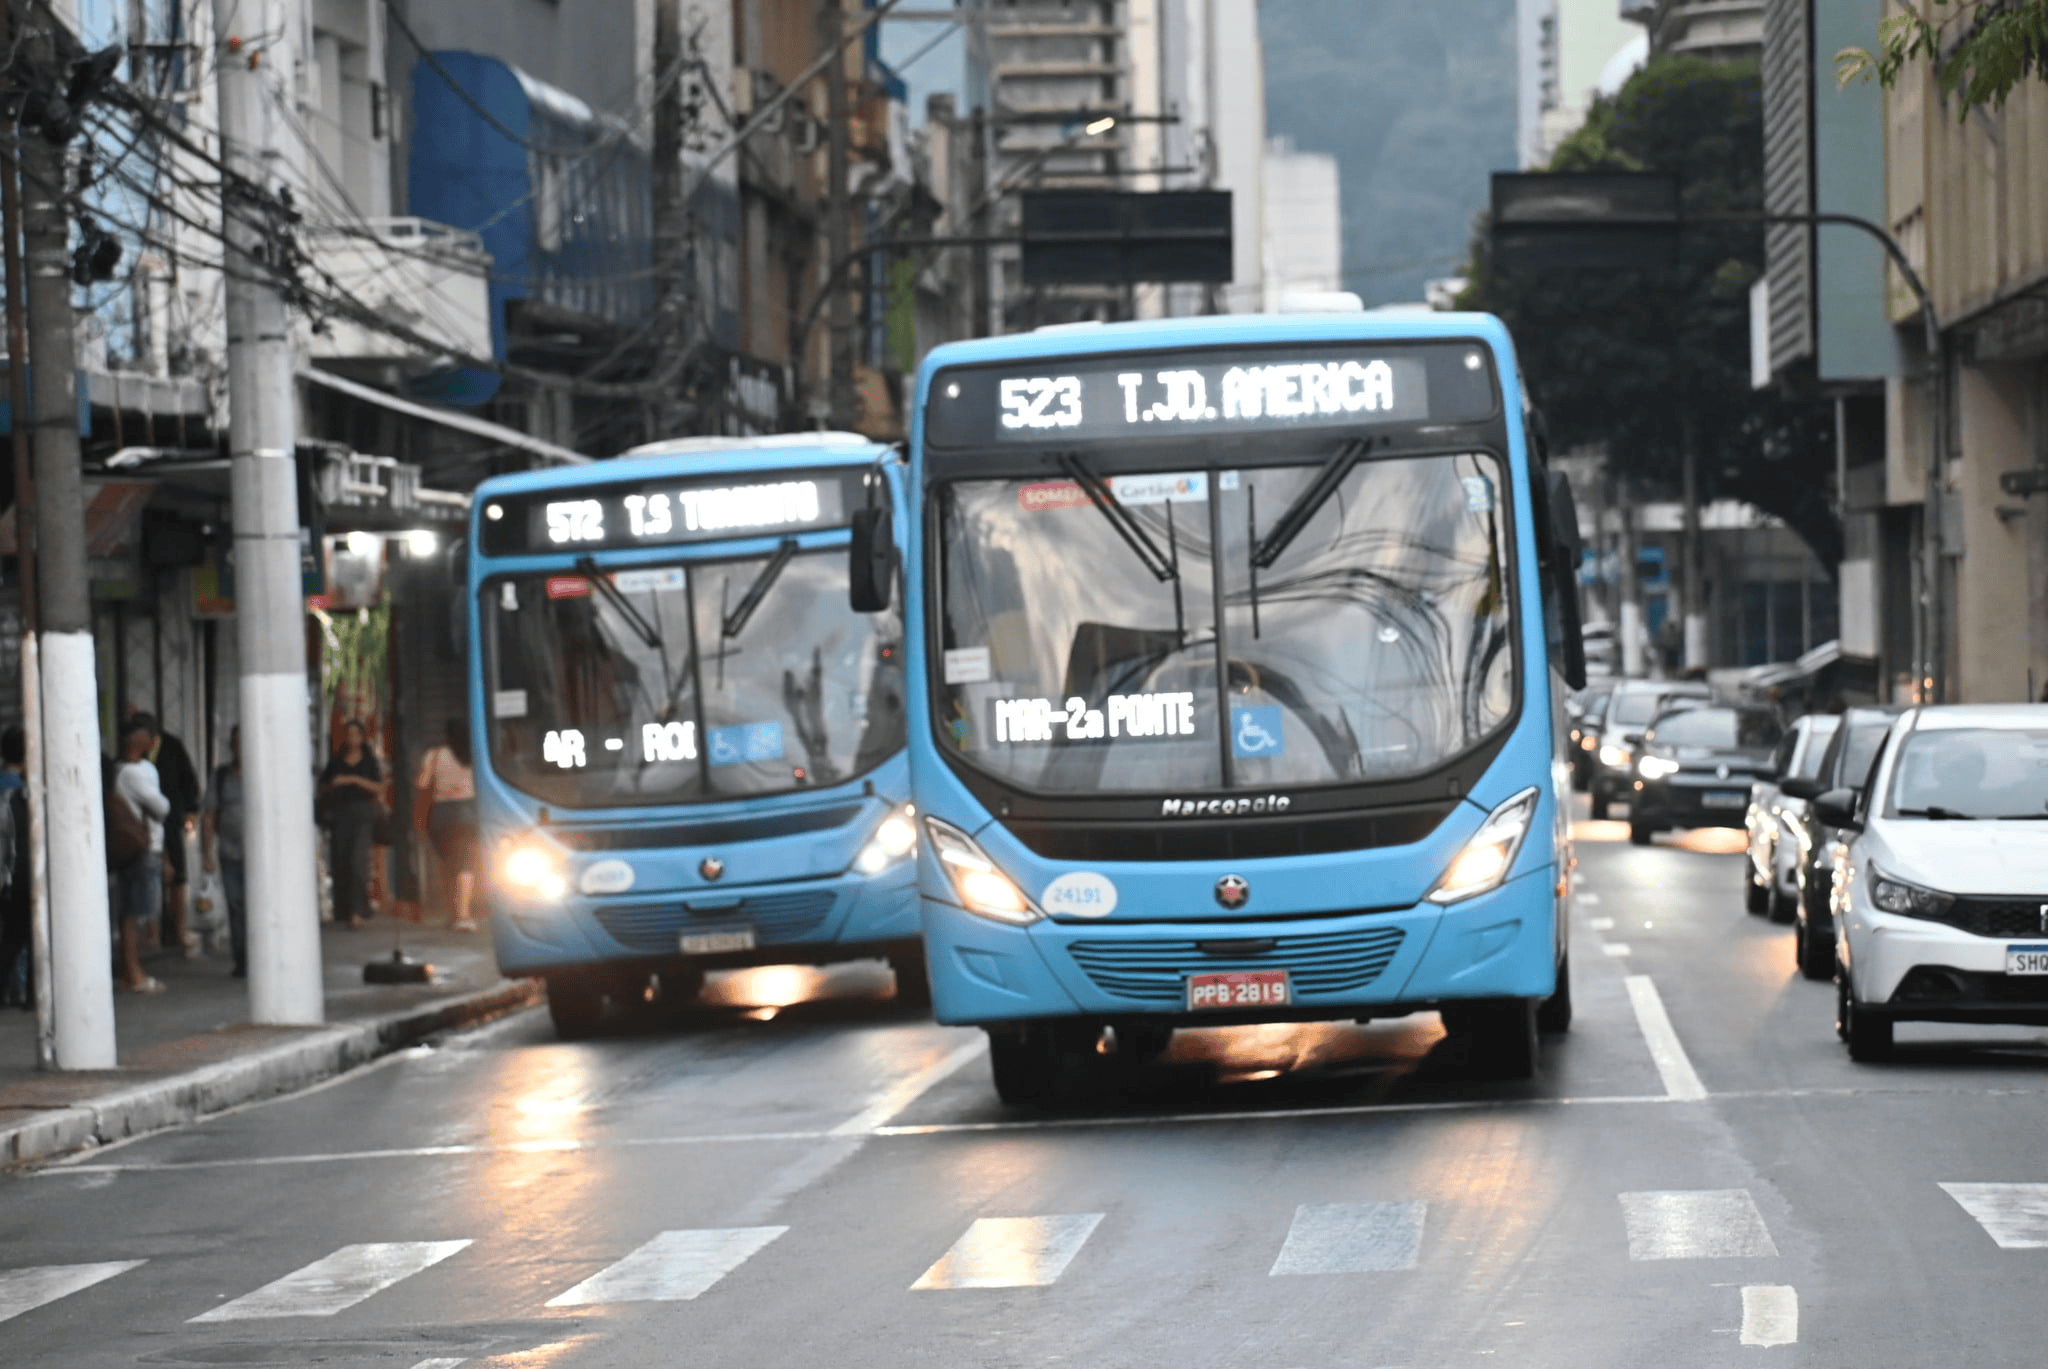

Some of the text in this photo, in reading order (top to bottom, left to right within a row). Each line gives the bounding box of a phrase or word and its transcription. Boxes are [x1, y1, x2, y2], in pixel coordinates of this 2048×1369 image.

[1000, 377, 1082, 428] 523
[1108, 692, 1195, 737] PONTE
[1162, 795, 1291, 816] Marcopolo
[1053, 886, 1102, 903] 24191
